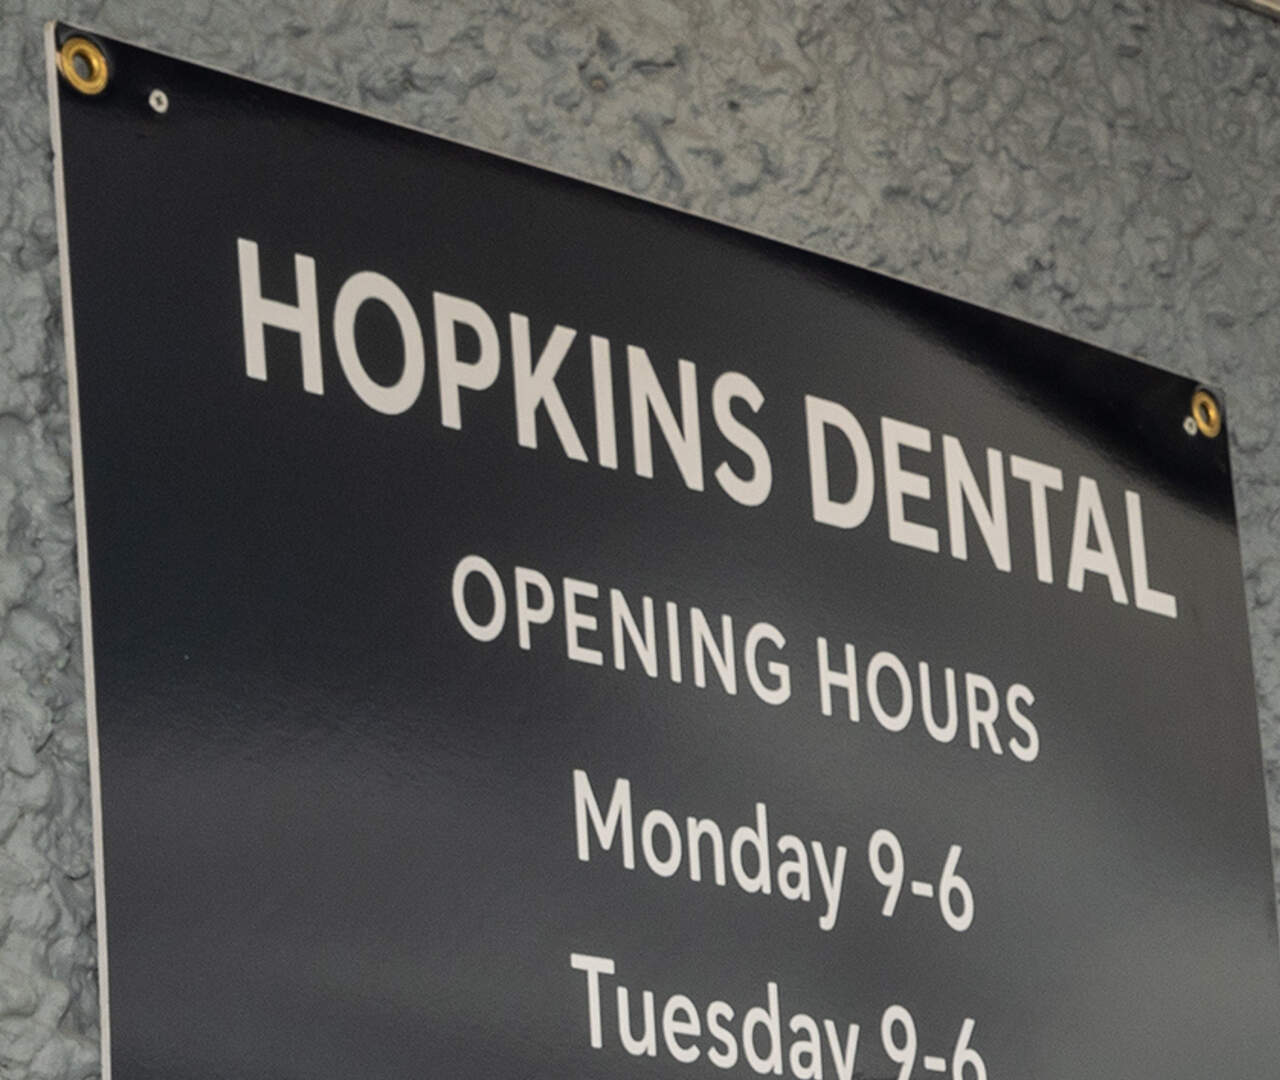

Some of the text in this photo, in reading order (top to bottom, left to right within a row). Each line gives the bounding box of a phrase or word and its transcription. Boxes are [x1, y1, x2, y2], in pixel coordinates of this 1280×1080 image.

[237, 237, 1178, 619] HOPKINS DENTAL
[452, 555, 1040, 763] OPENING HOURS
[572, 769, 975, 932] Monday 9-6
